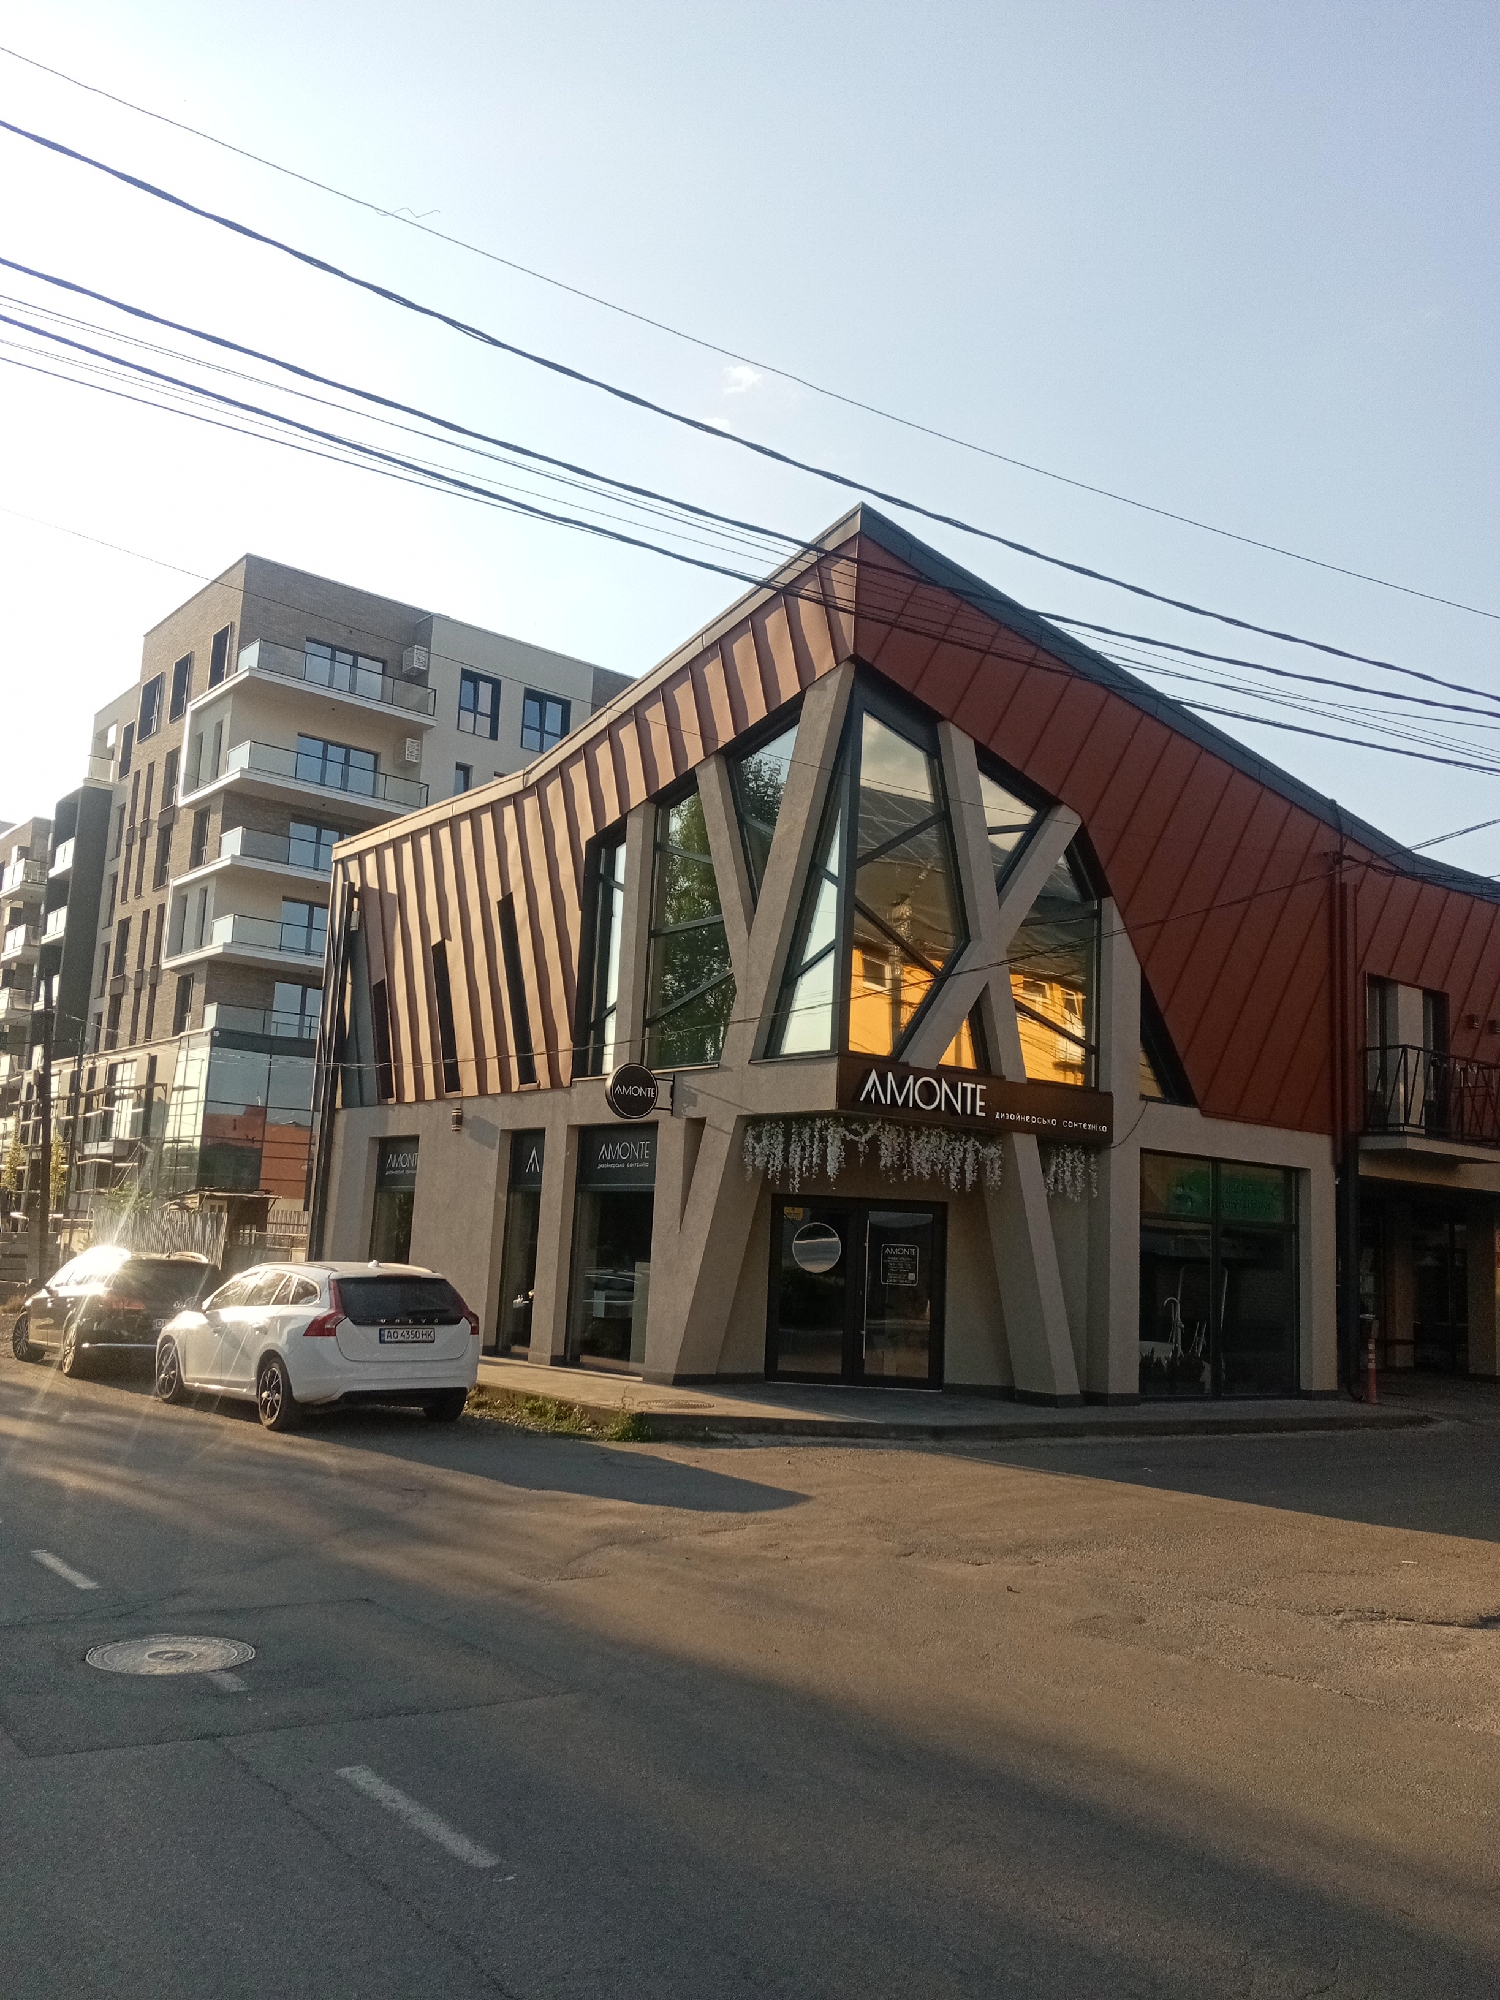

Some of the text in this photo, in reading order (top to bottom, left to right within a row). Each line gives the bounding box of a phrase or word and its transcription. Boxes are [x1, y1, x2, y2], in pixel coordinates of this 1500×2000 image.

[614, 1084, 655, 1098] AMONTE
[859, 1068, 987, 1117] AMONTE
[598, 1141, 651, 1160] AMONTE
[386, 1152, 419, 1168] AMONT
